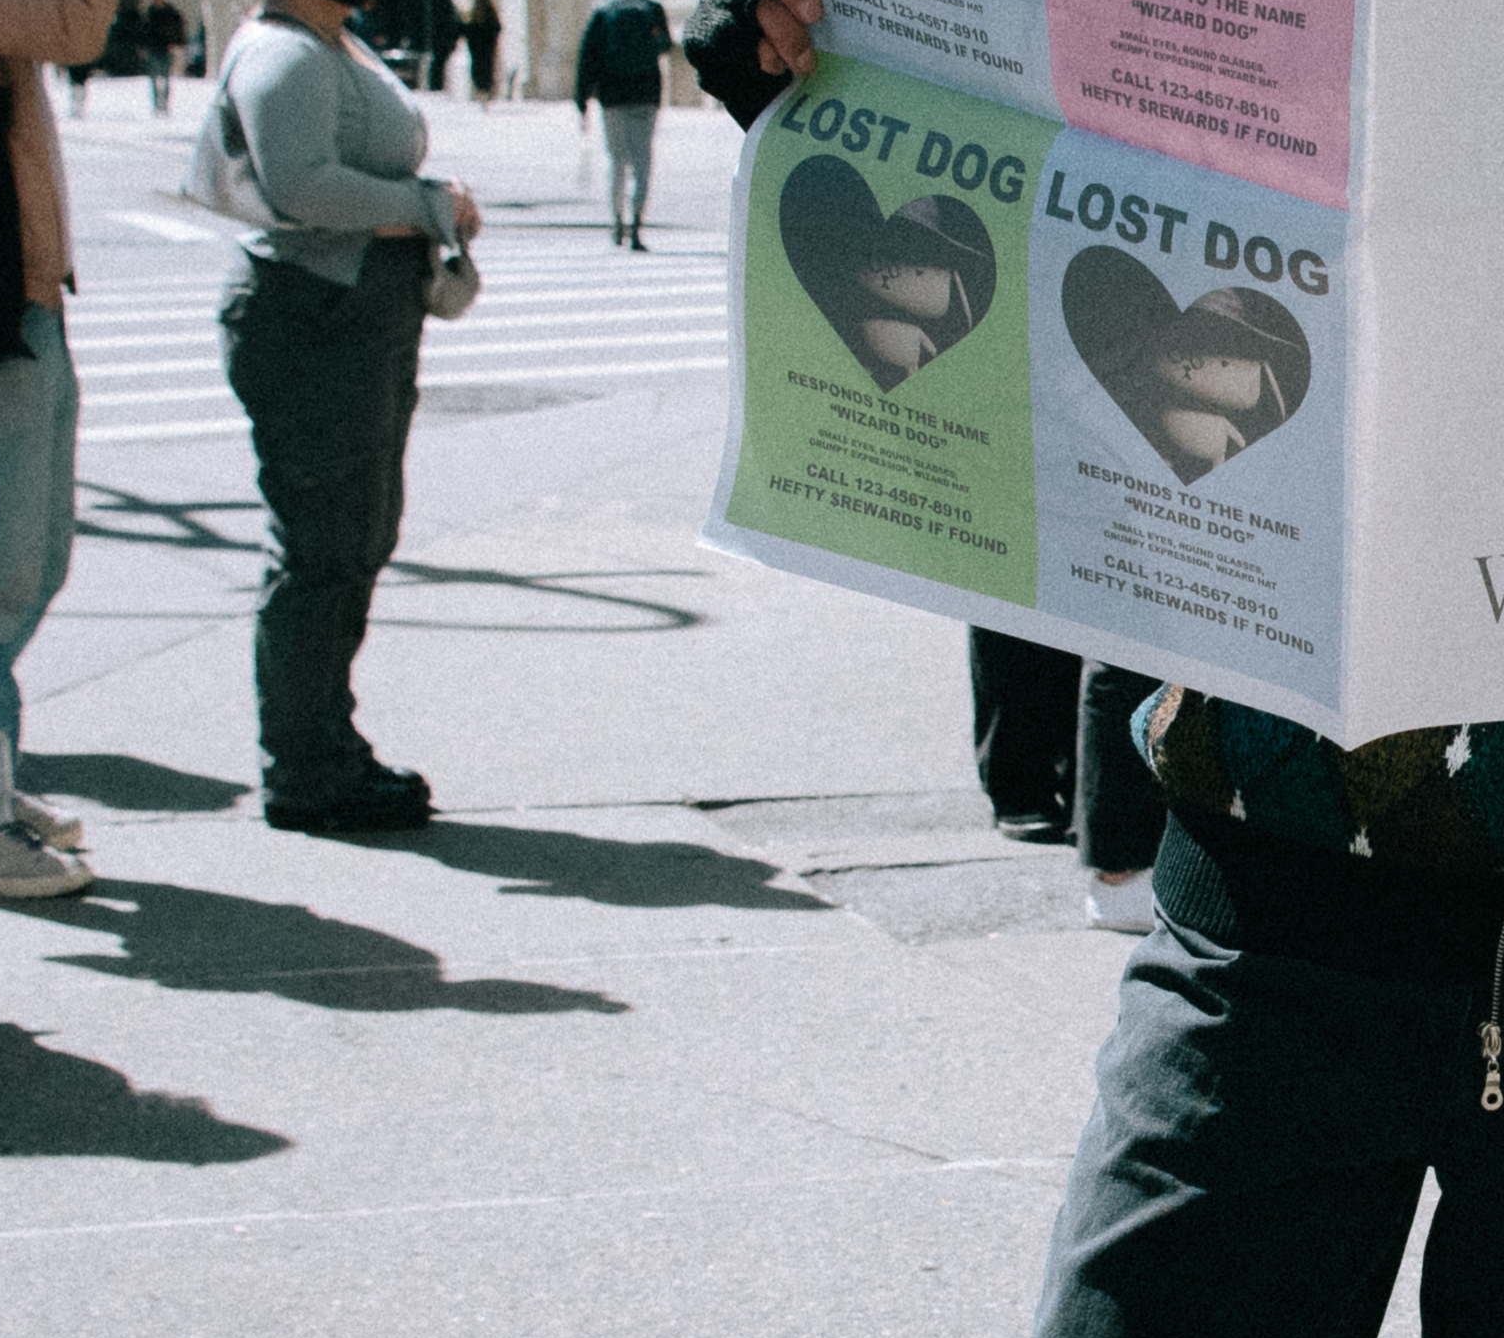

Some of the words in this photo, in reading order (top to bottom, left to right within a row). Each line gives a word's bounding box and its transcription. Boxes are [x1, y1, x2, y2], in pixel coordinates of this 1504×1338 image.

[832, 0, 873, 26] HEFTY
[955, 43, 967, 57] IF
[973, 48, 1023, 74] FOUND
[892, 2, 988, 45] 123-4567-8910
[1255, 4, 1306, 28] NAME
[1081, 83, 1133, 109] HEFTY
[1235, 122, 1251, 140] IF
[1256, 128, 1318, 157] FOUND
[1112, 68, 1154, 91] CALL
[1160, 80, 1280, 123] 123-4567-8910
[780, 93, 909, 162] LOST
[916, 133, 1026, 203] DOG
[1045, 169, 1187, 253] LOST
[1204, 221, 1330, 296] DOG
[788, 371, 873, 408] RESPONDS
[878, 398, 900, 415] TO
[905, 408, 937, 428] THE
[943, 419, 990, 445] NAME
[770, 475, 825, 502] HEFTY
[929, 520, 944, 535] IF
[949, 527, 1008, 555] FOUND
[807, 464, 848, 487] CALL
[855, 477, 972, 523] 123-4567-8910
[1078, 461, 1172, 501] RESPONDS
[1178, 492, 1202, 510] TO
[1207, 500, 1243, 523] THE
[1249, 512, 1300, 541] NAME
[1071, 564, 1126, 592] HEFTY
[1234, 615, 1248, 631] IF
[1255, 622, 1314, 655] FOUND
[1104, 555, 1148, 579] CALL
[1154, 571, 1278, 620] 123-4567-8910
